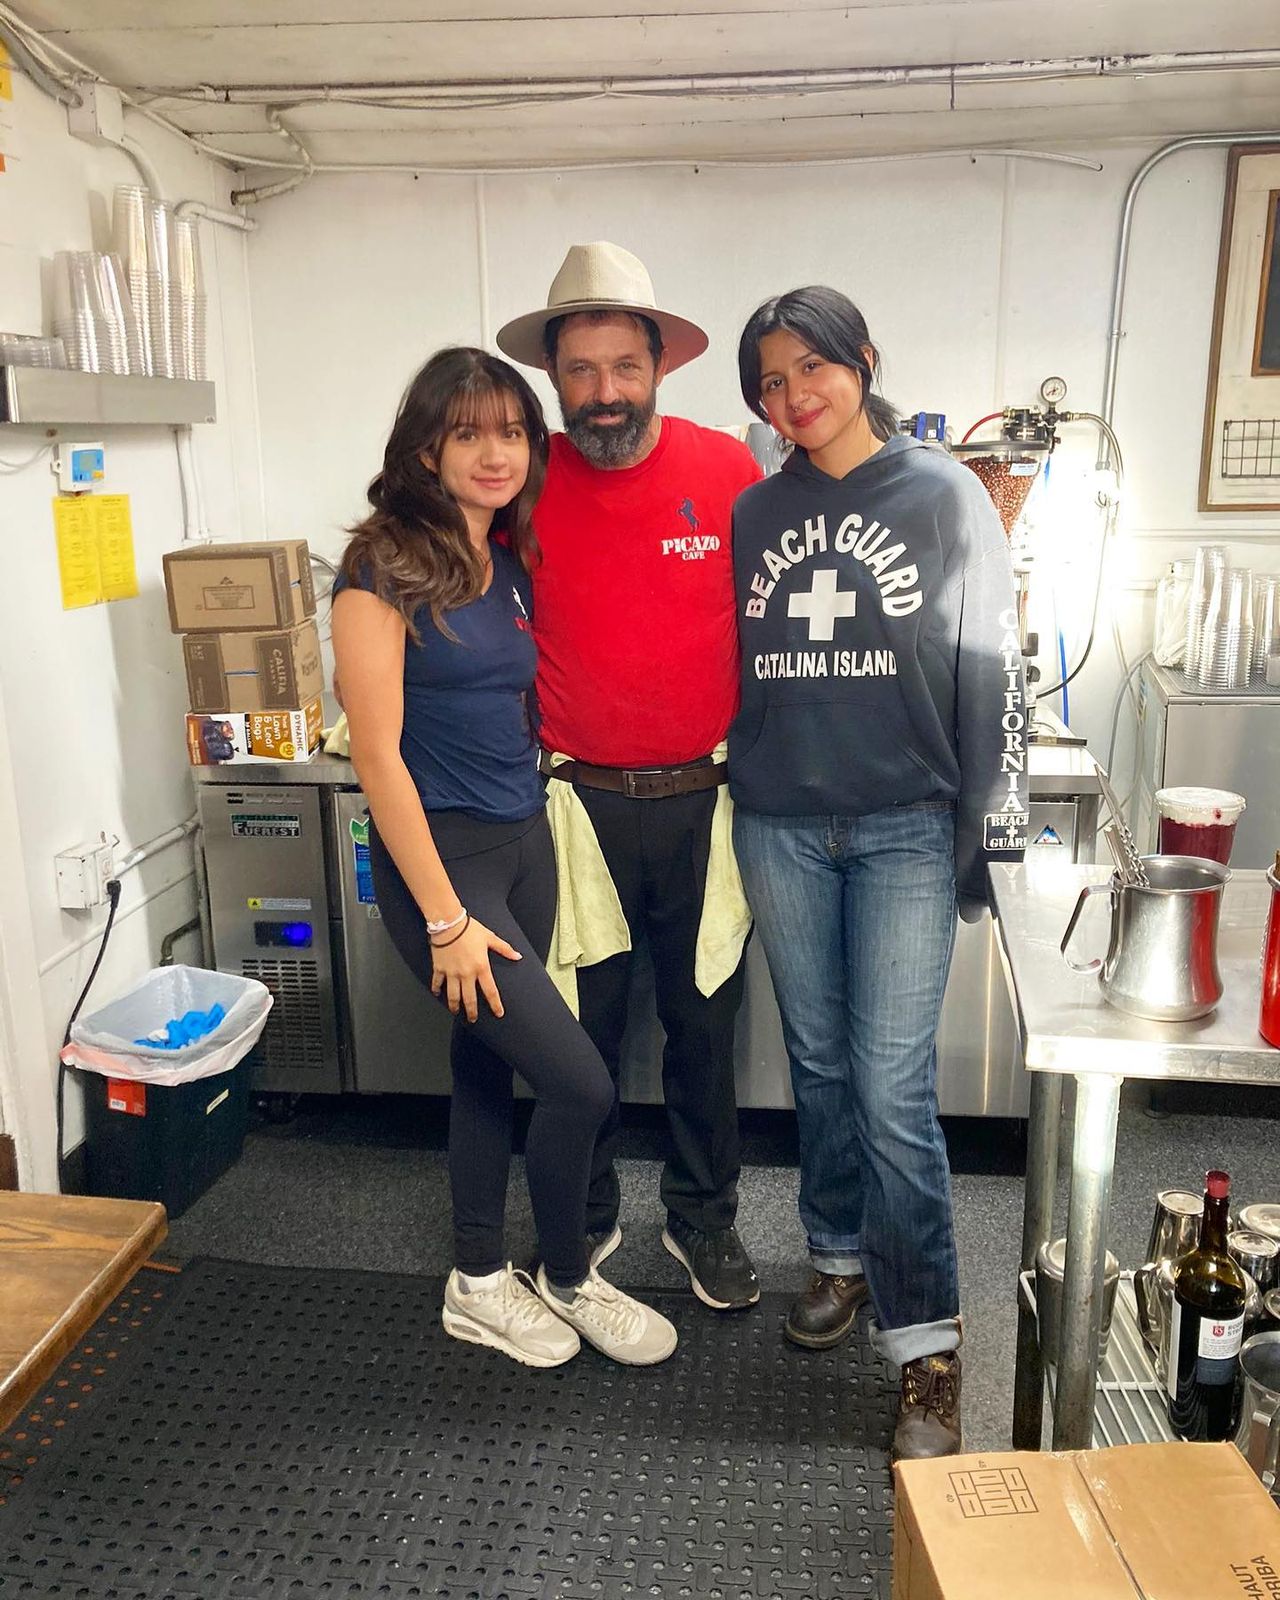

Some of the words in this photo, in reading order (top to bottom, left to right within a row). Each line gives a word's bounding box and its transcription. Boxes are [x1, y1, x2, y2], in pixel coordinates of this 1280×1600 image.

[661, 535, 721, 555] PICAZO
[682, 551, 705, 561] CAFE
[745, 514, 828, 619] BEACH
[834, 513, 924, 618] GUARD
[272, 649, 288, 695] CALIFIA
[754, 651, 828, 680] CATALINA
[833, 649, 898, 677] ISLAND
[998, 608, 1026, 813] CALIFORNIA
[254, 716, 262, 740] Bags
[265, 726, 274, 749] Leaf
[273, 716, 281, 740] Lawn
[294, 714, 304, 751] DYNAMIC
[233, 822, 297, 836] EVEREST
